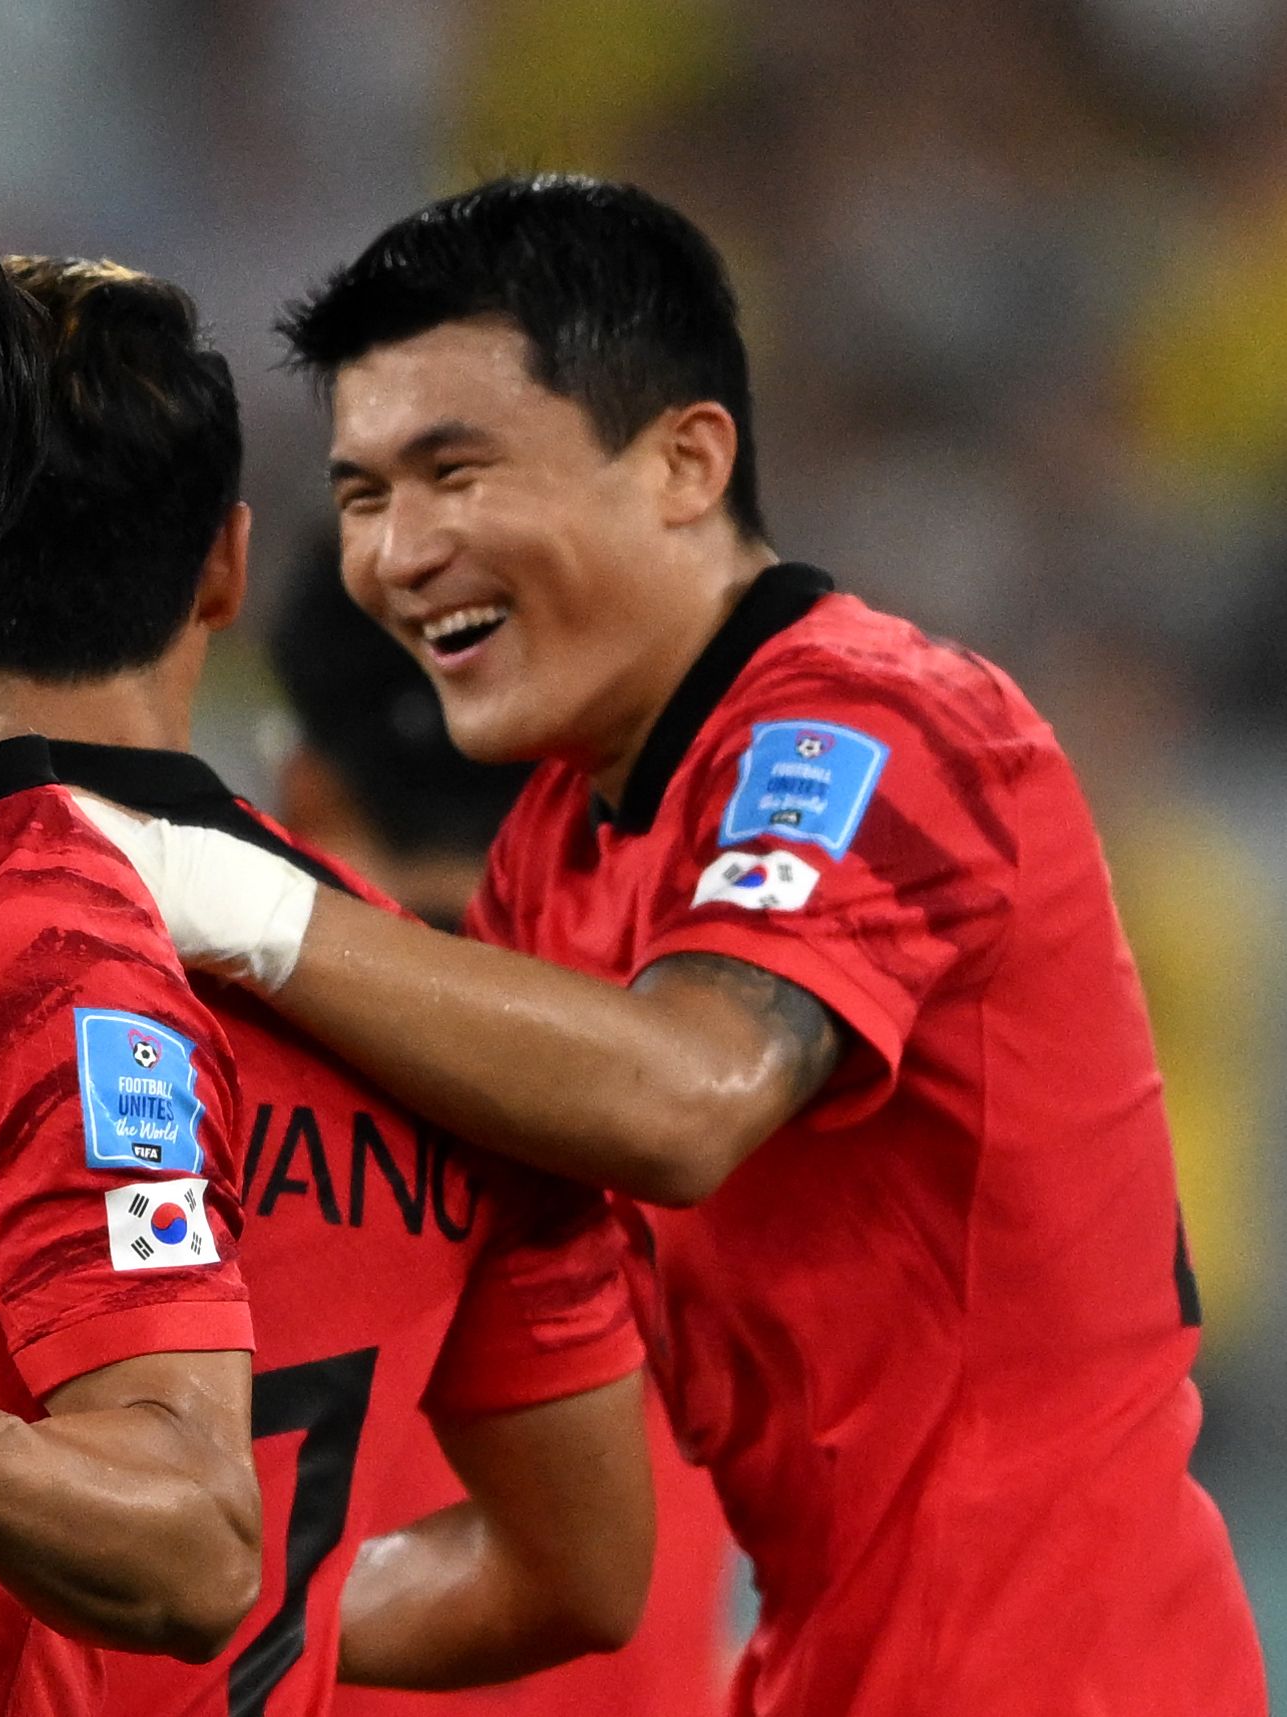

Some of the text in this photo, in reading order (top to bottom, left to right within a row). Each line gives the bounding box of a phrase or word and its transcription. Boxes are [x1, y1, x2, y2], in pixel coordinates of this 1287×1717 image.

[119, 1076, 172, 1099] FOOTBALL
[119, 1094, 174, 1121] UNITES
[115, 1116, 179, 1144] the World
[134, 1146, 158, 1159] FIFA
[239, 1103, 486, 1243] ANG
